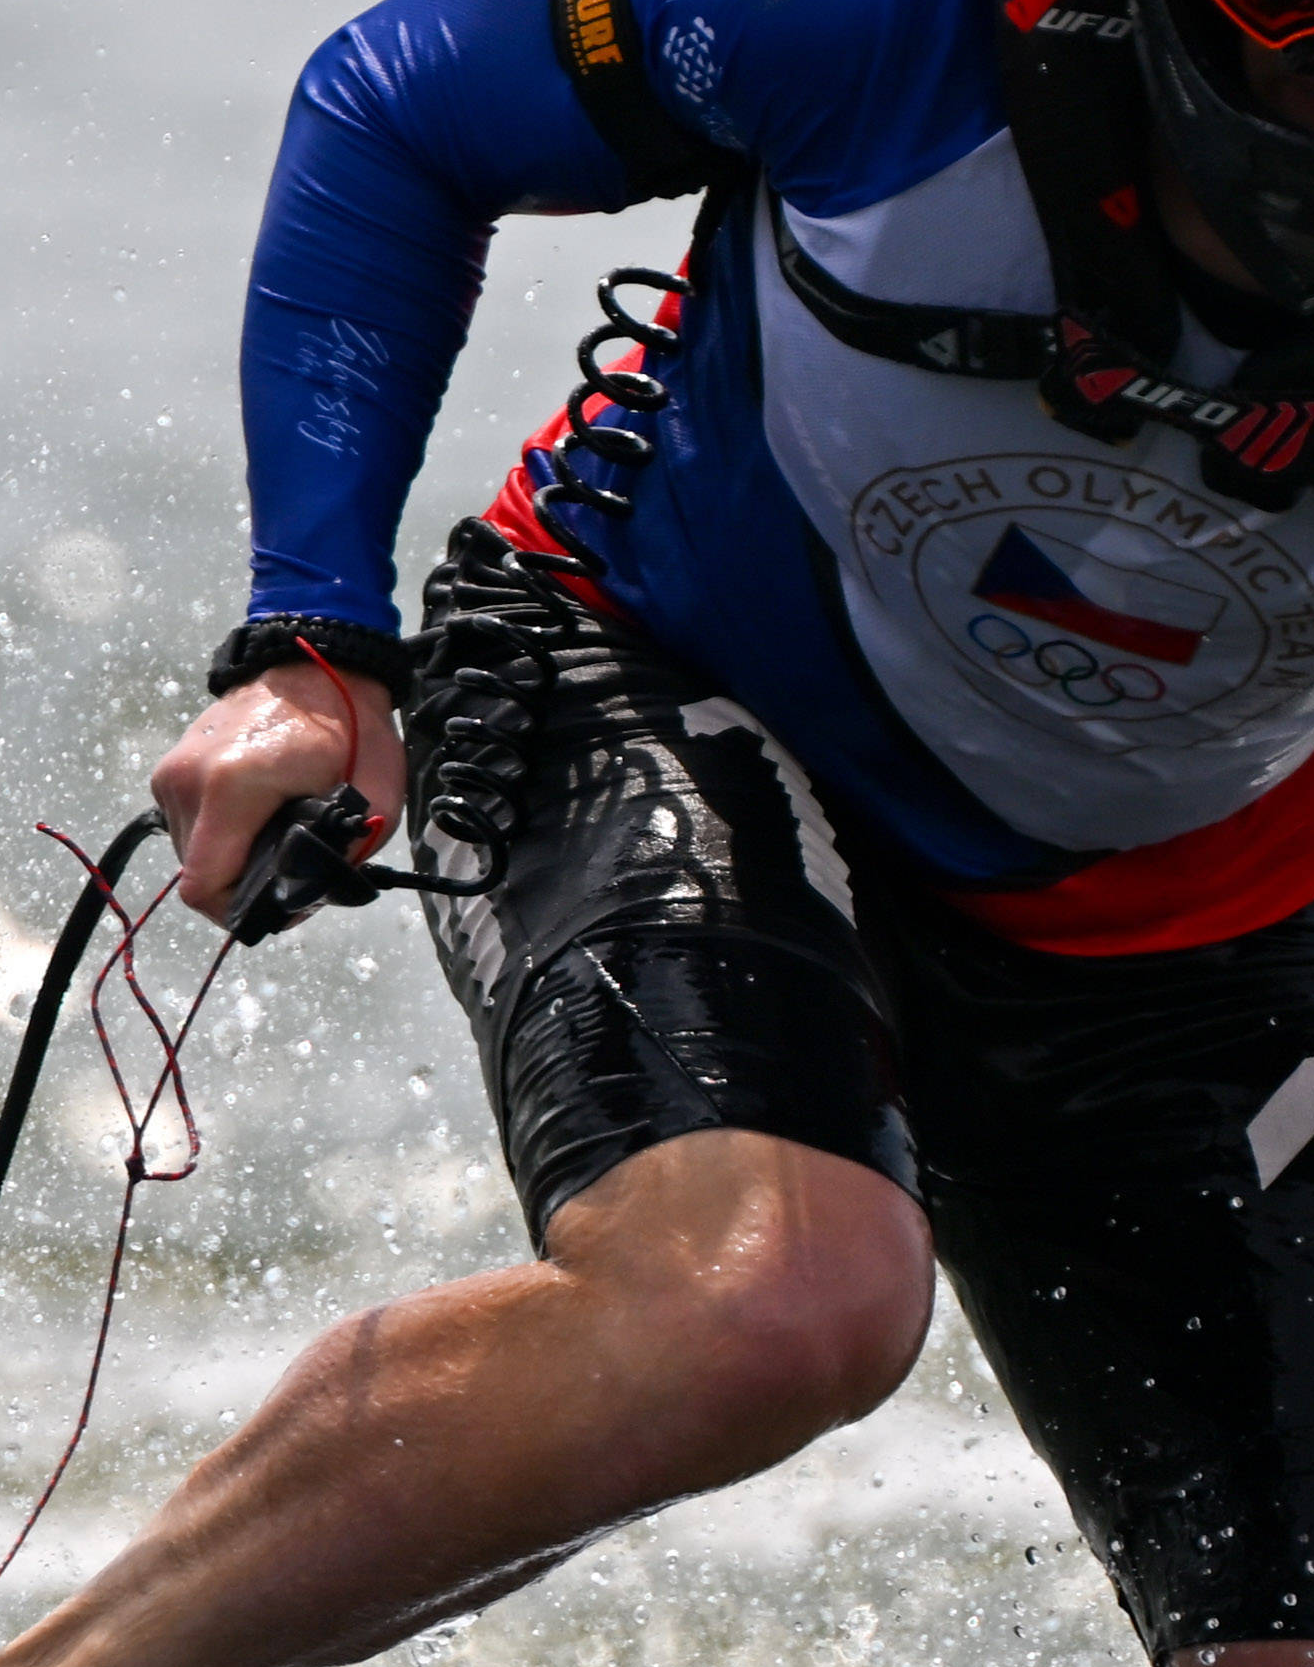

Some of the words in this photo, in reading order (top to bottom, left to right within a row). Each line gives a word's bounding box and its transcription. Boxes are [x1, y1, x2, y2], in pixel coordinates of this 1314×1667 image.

[1037, 7, 1135, 39] UFO
[1122, 377, 1239, 427] UFO
[864, 468, 1003, 557] CZECH
[1026, 464, 1294, 595] OLYMPIC
